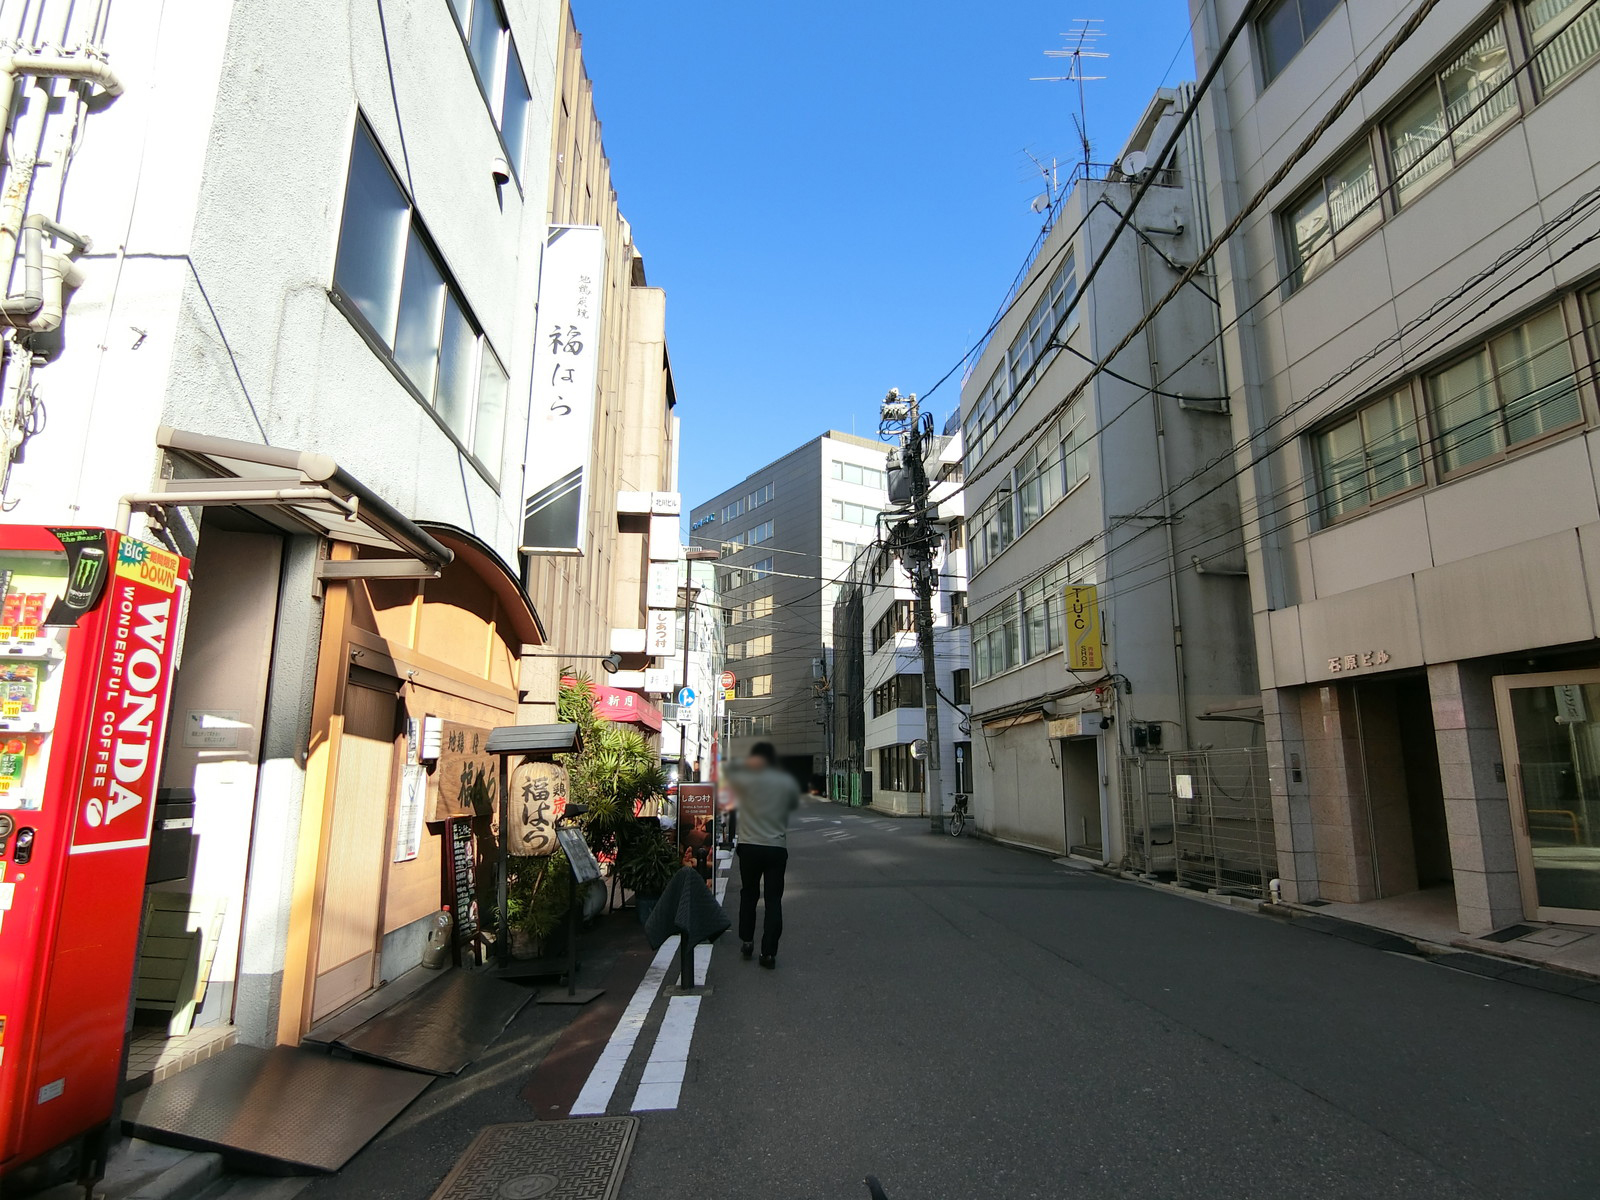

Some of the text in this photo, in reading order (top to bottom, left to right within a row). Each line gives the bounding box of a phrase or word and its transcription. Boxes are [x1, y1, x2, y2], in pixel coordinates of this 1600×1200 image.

[548, 325, 584, 416] 福はら
[61, 535, 76, 543] the
[124, 543, 144, 561] BIG
[140, 561, 176, 589] DOWN
[655, 613, 667, 648] しあつ村
[1327, 649, 1391, 673] 石原ビル
[93, 586, 136, 788] WONDERFUL COFFEE
[607, 694, 634, 707] 新月
[104, 598, 171, 825] WONDA
[521, 775, 551, 850] 福はら
[682, 794, 711, 803] しあつ村
